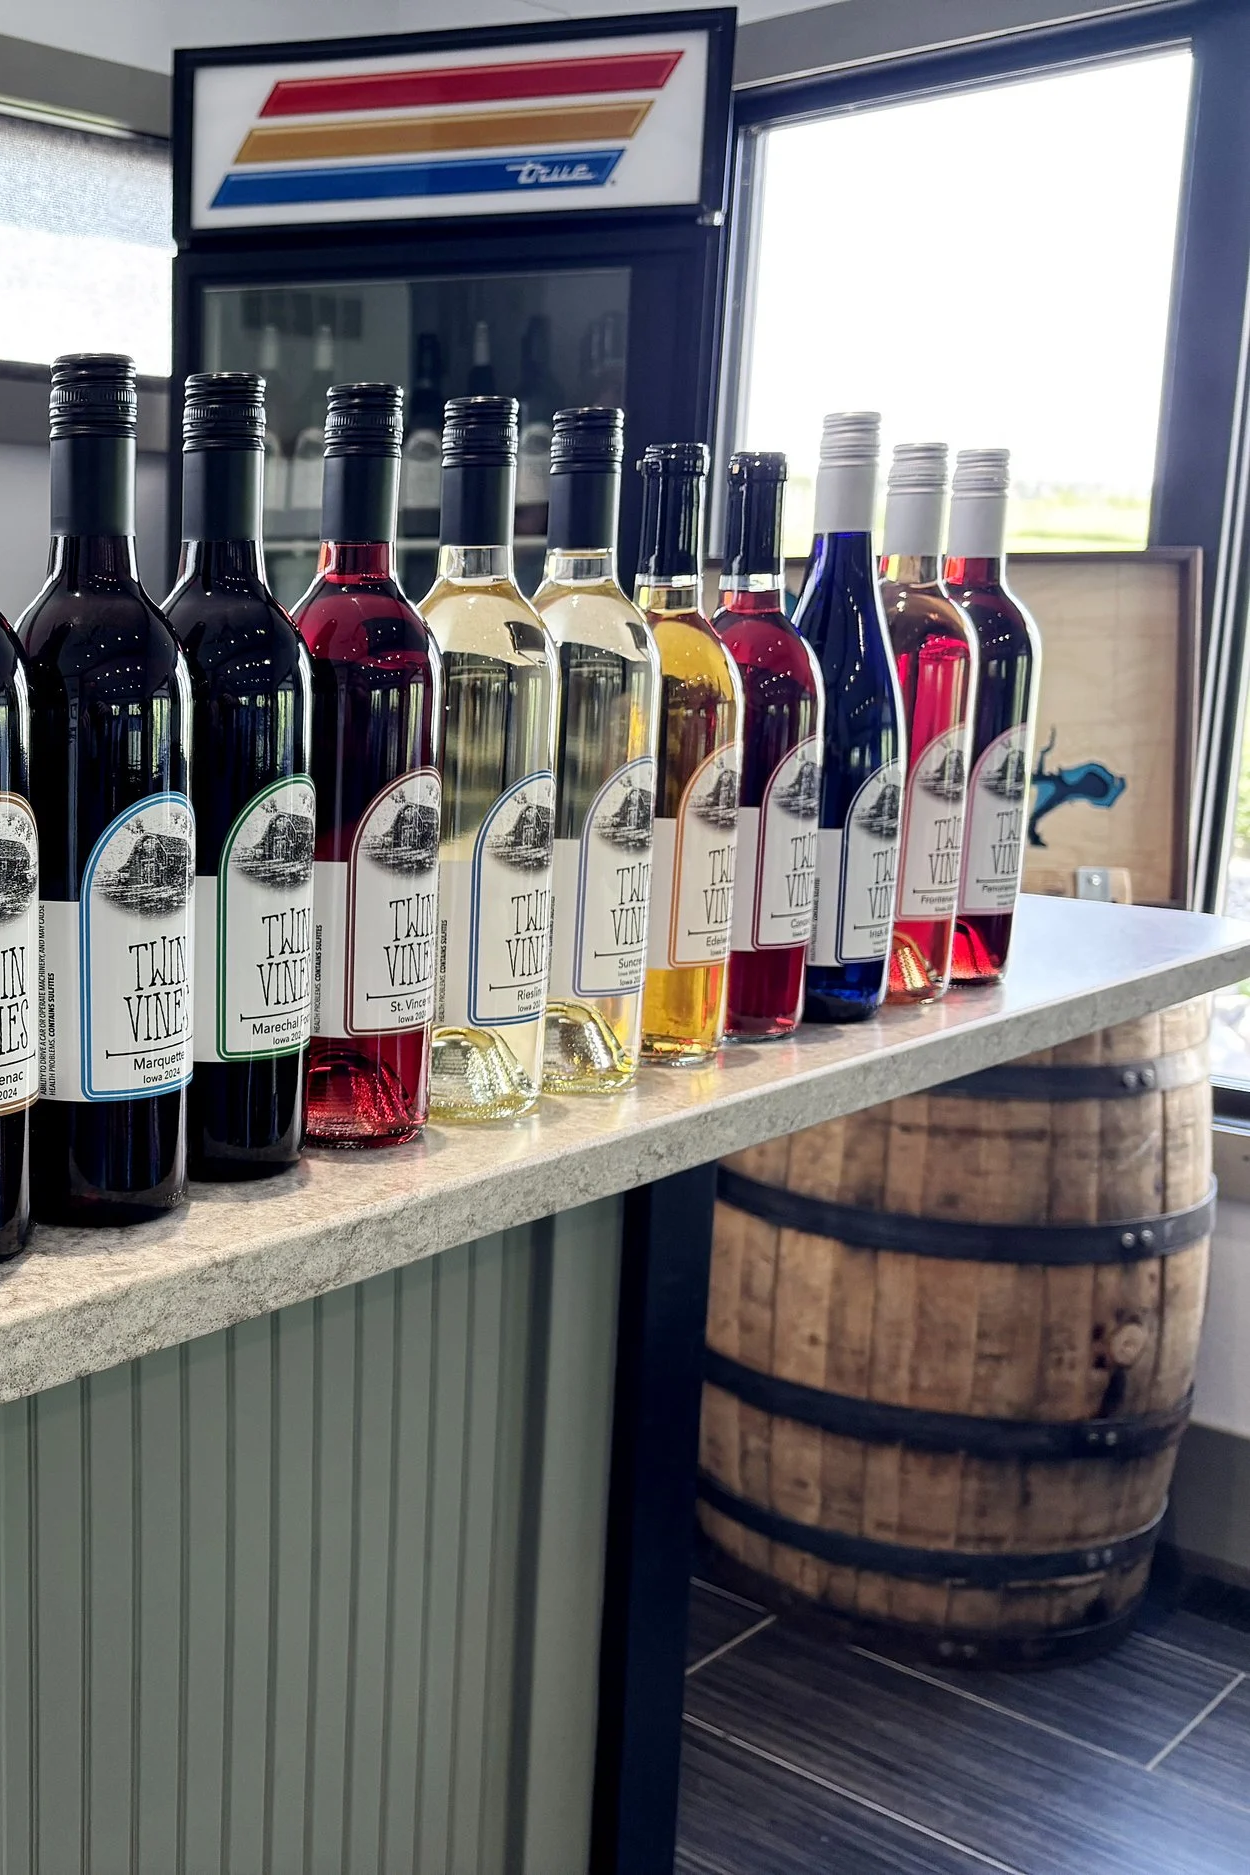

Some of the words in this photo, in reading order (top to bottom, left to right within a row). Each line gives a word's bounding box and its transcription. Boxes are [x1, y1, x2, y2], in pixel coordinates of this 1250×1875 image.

[389, 893, 434, 942] TWIN
[261, 907, 311, 960] TWIN
[128, 935, 190, 992] TWIN
[505, 934, 547, 978] VINE
[47, 972, 55, 1003] SULFITES
[517, 987, 542, 1001] Rieslin
[123, 985, 191, 1042] VINES
[390, 1001, 404, 1012] St.
[405, 996, 431, 1010] Vince
[518, 1004, 532, 1013] Iowa
[47, 1003, 55, 1037] CONTAINS
[252, 1019, 299, 1035] Marechal
[398, 1015, 414, 1024] Iowa
[272, 1035, 290, 1045] Iowa
[48, 1037, 56, 1072] PROBLEMS.
[133, 1049, 185, 1071] Marquette
[48, 1073, 56, 1096] HEALTH
[143, 1072, 163, 1084] Iowa
